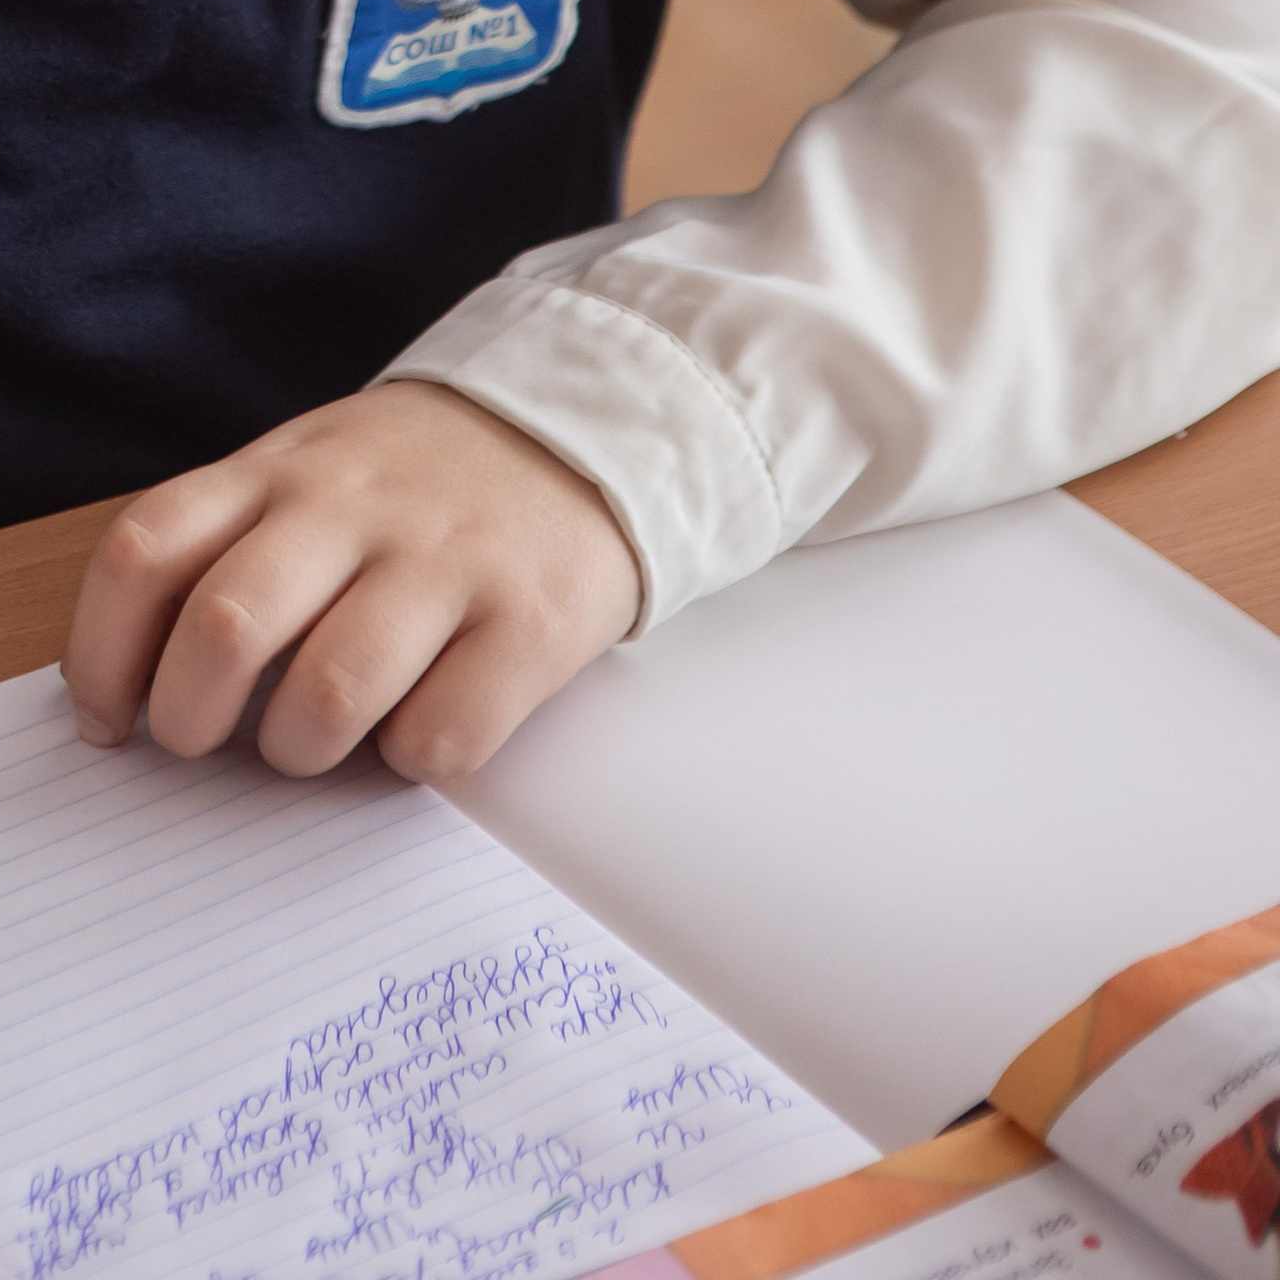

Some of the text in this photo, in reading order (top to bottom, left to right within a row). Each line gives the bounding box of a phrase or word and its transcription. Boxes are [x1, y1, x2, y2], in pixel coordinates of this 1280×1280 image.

[385, 15, 522, 66] СОШ №1
[216, 1040, 370, 1140] остров
